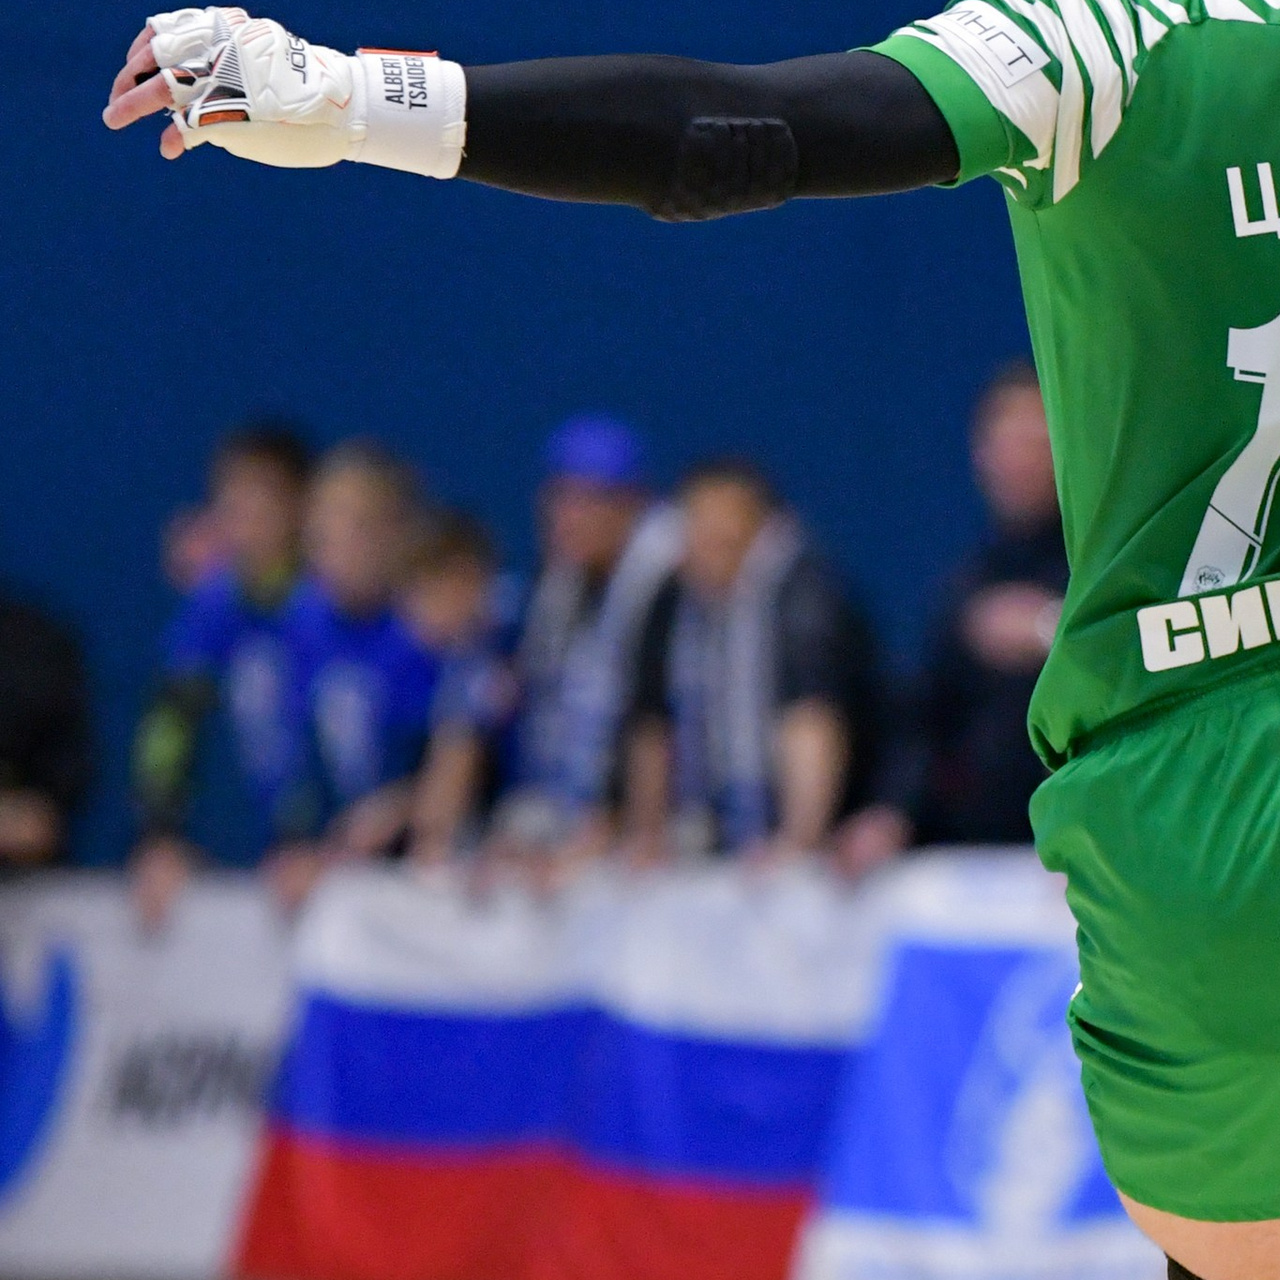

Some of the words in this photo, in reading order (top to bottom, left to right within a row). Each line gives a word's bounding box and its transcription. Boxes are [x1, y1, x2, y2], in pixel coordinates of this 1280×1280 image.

[944, 5, 1033, 67] ИНГТ
[380, 57, 404, 105] ALBERT
[404, 57, 428, 110] TSAIDER
